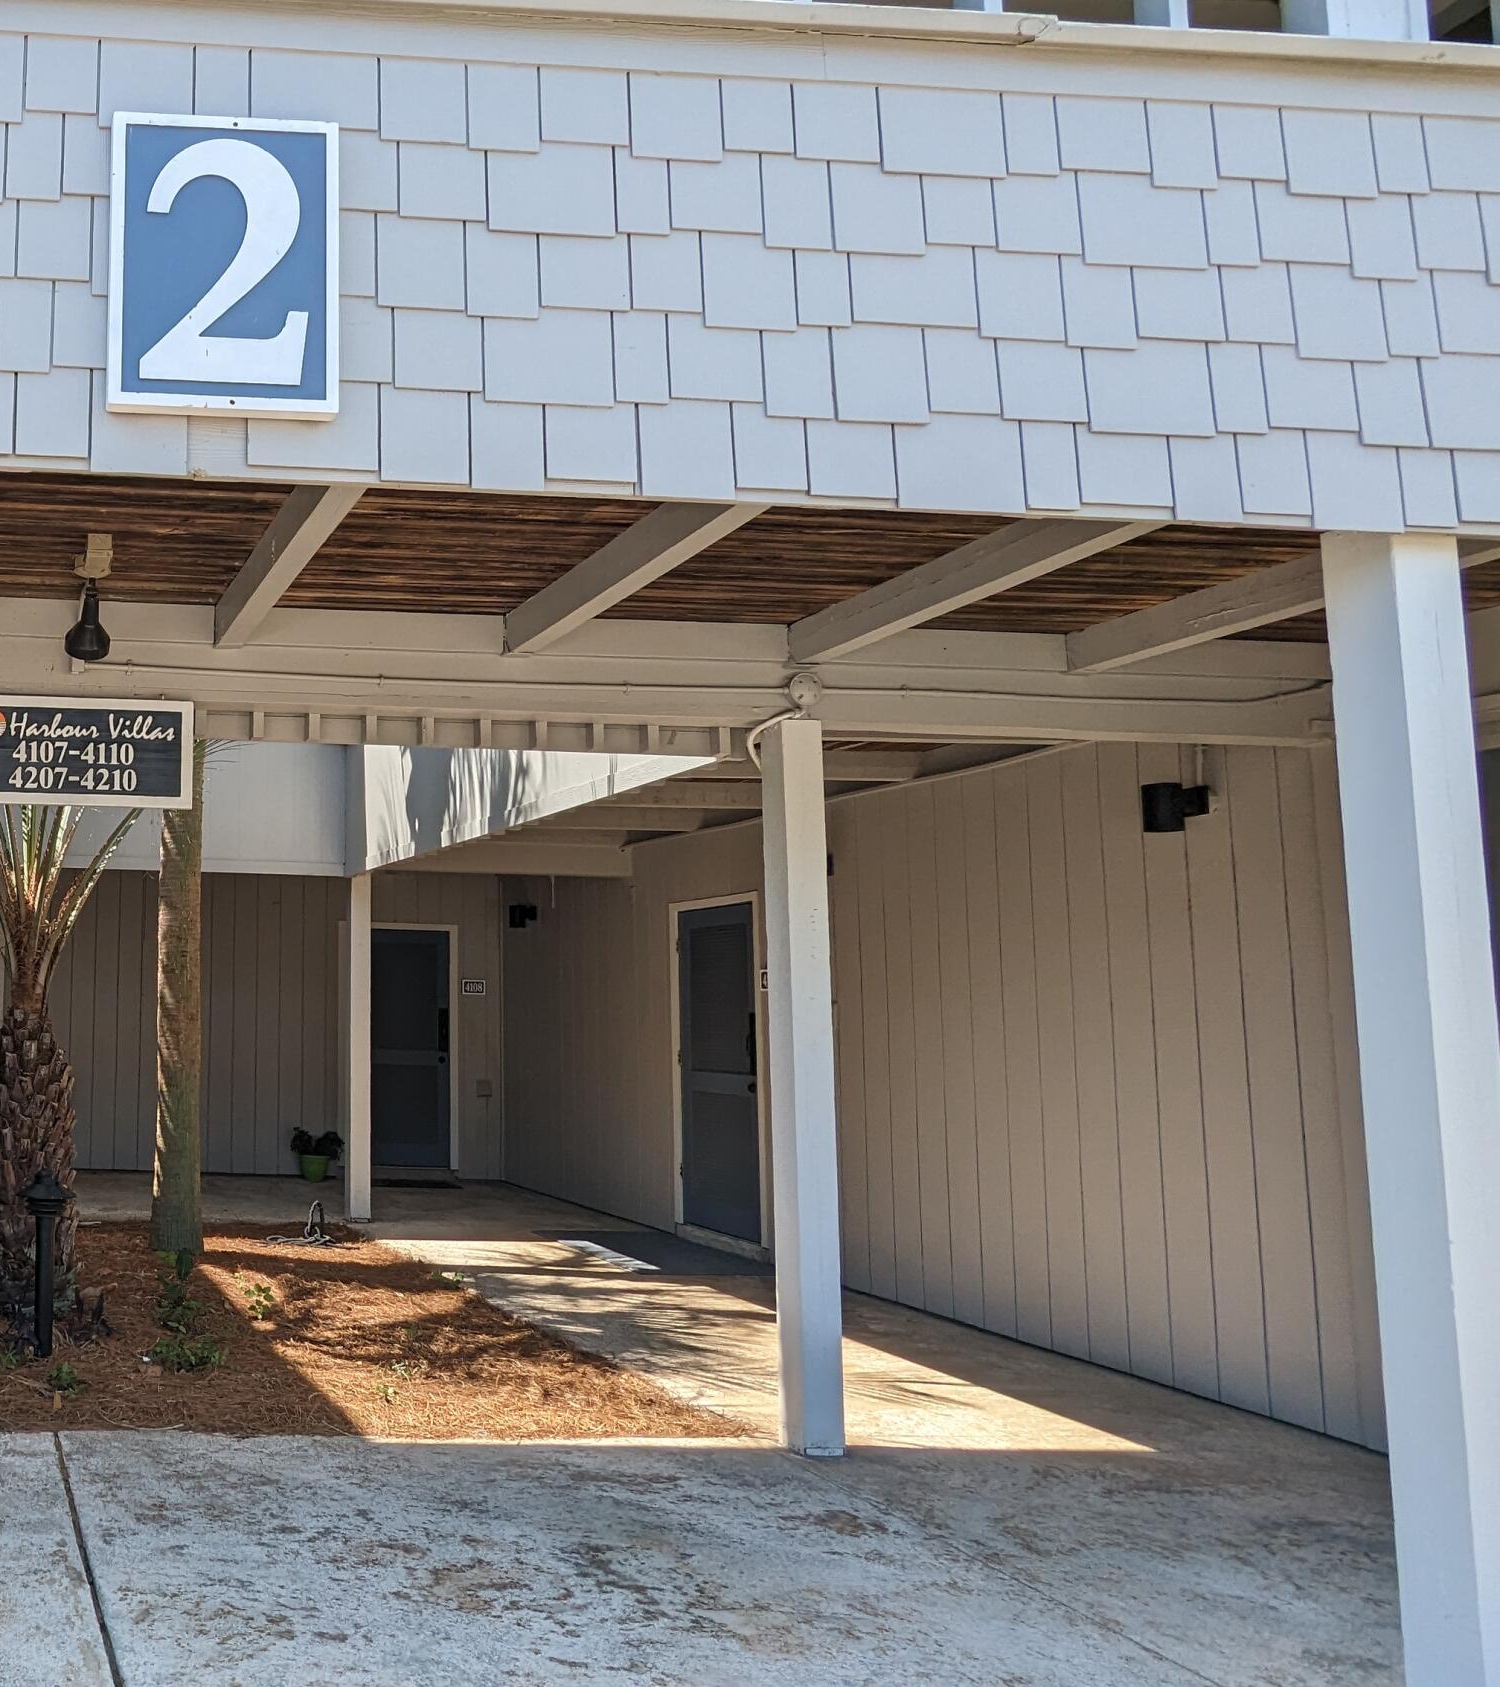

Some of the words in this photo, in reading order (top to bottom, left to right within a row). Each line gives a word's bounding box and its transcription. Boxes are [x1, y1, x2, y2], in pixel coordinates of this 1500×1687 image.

[139, 138, 309, 386] 2
[9, 711, 99, 739] Harbour
[108, 712, 175, 742] Villas
[12, 740, 135, 766] 4107-4110
[8, 766, 137, 792] 4207-4210
[464, 982, 483, 993] 4108
